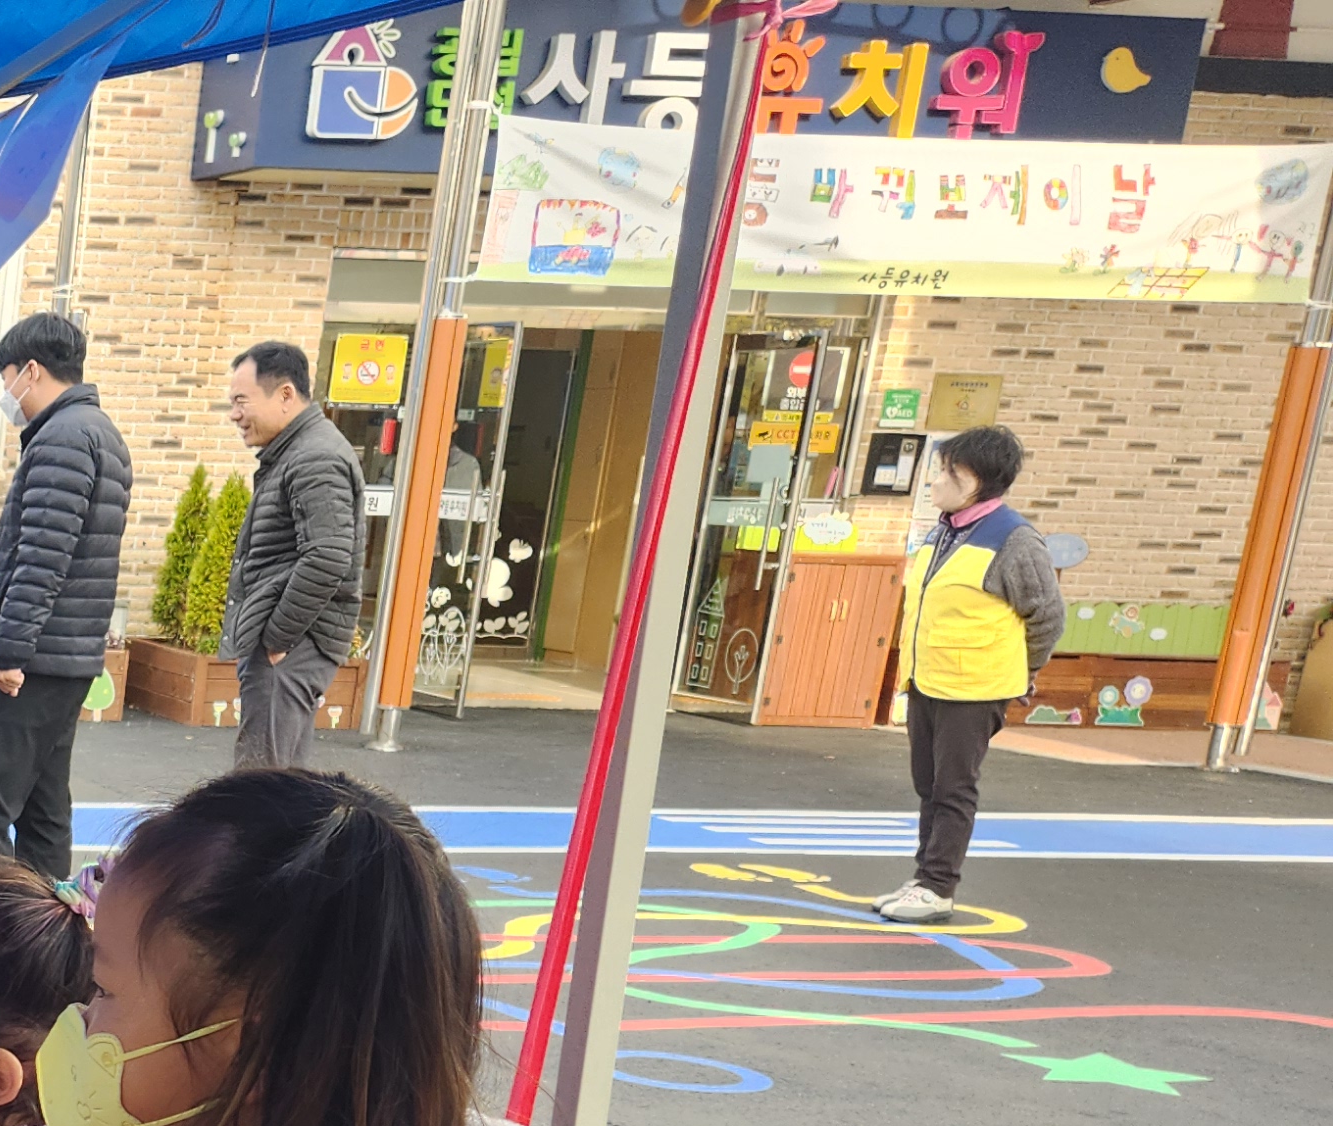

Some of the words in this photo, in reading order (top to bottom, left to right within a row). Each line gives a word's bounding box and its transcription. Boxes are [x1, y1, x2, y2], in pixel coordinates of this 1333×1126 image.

[742, 157, 781, 228] 등
[1107, 163, 1157, 234] 날
[857, 267, 950, 290] 사등유치원
